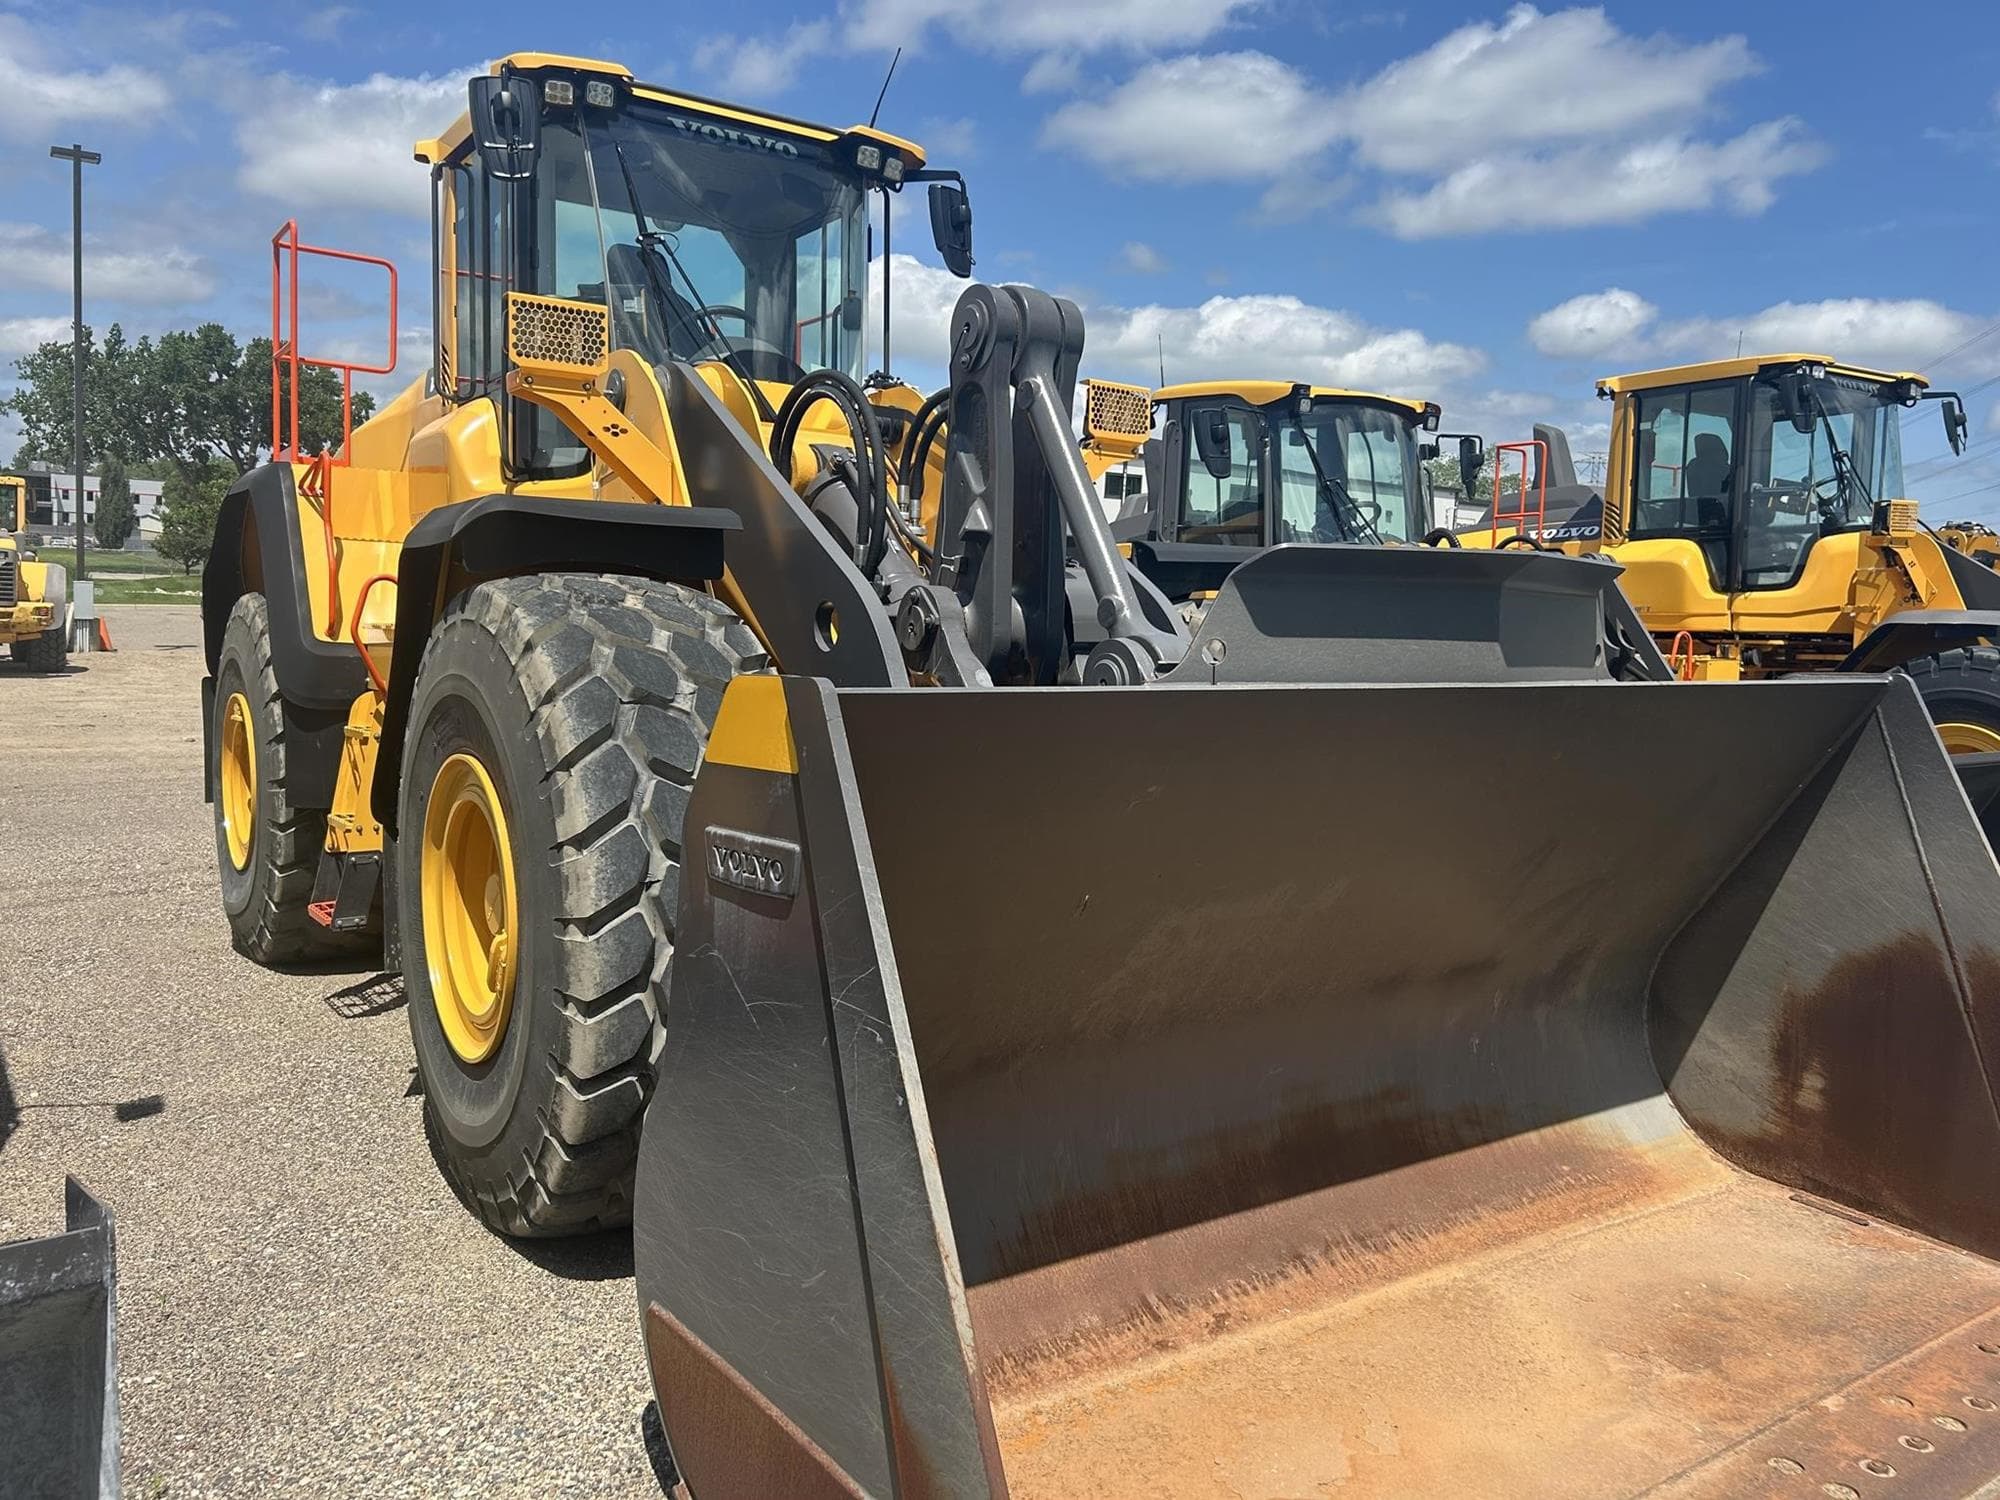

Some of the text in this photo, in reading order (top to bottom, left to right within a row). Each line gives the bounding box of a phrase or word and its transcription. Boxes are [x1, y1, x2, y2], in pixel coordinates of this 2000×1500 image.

[667, 116, 799, 159] VOLVO
[1527, 525, 1600, 540] VOLVO
[712, 845, 785, 885] VOLVO
